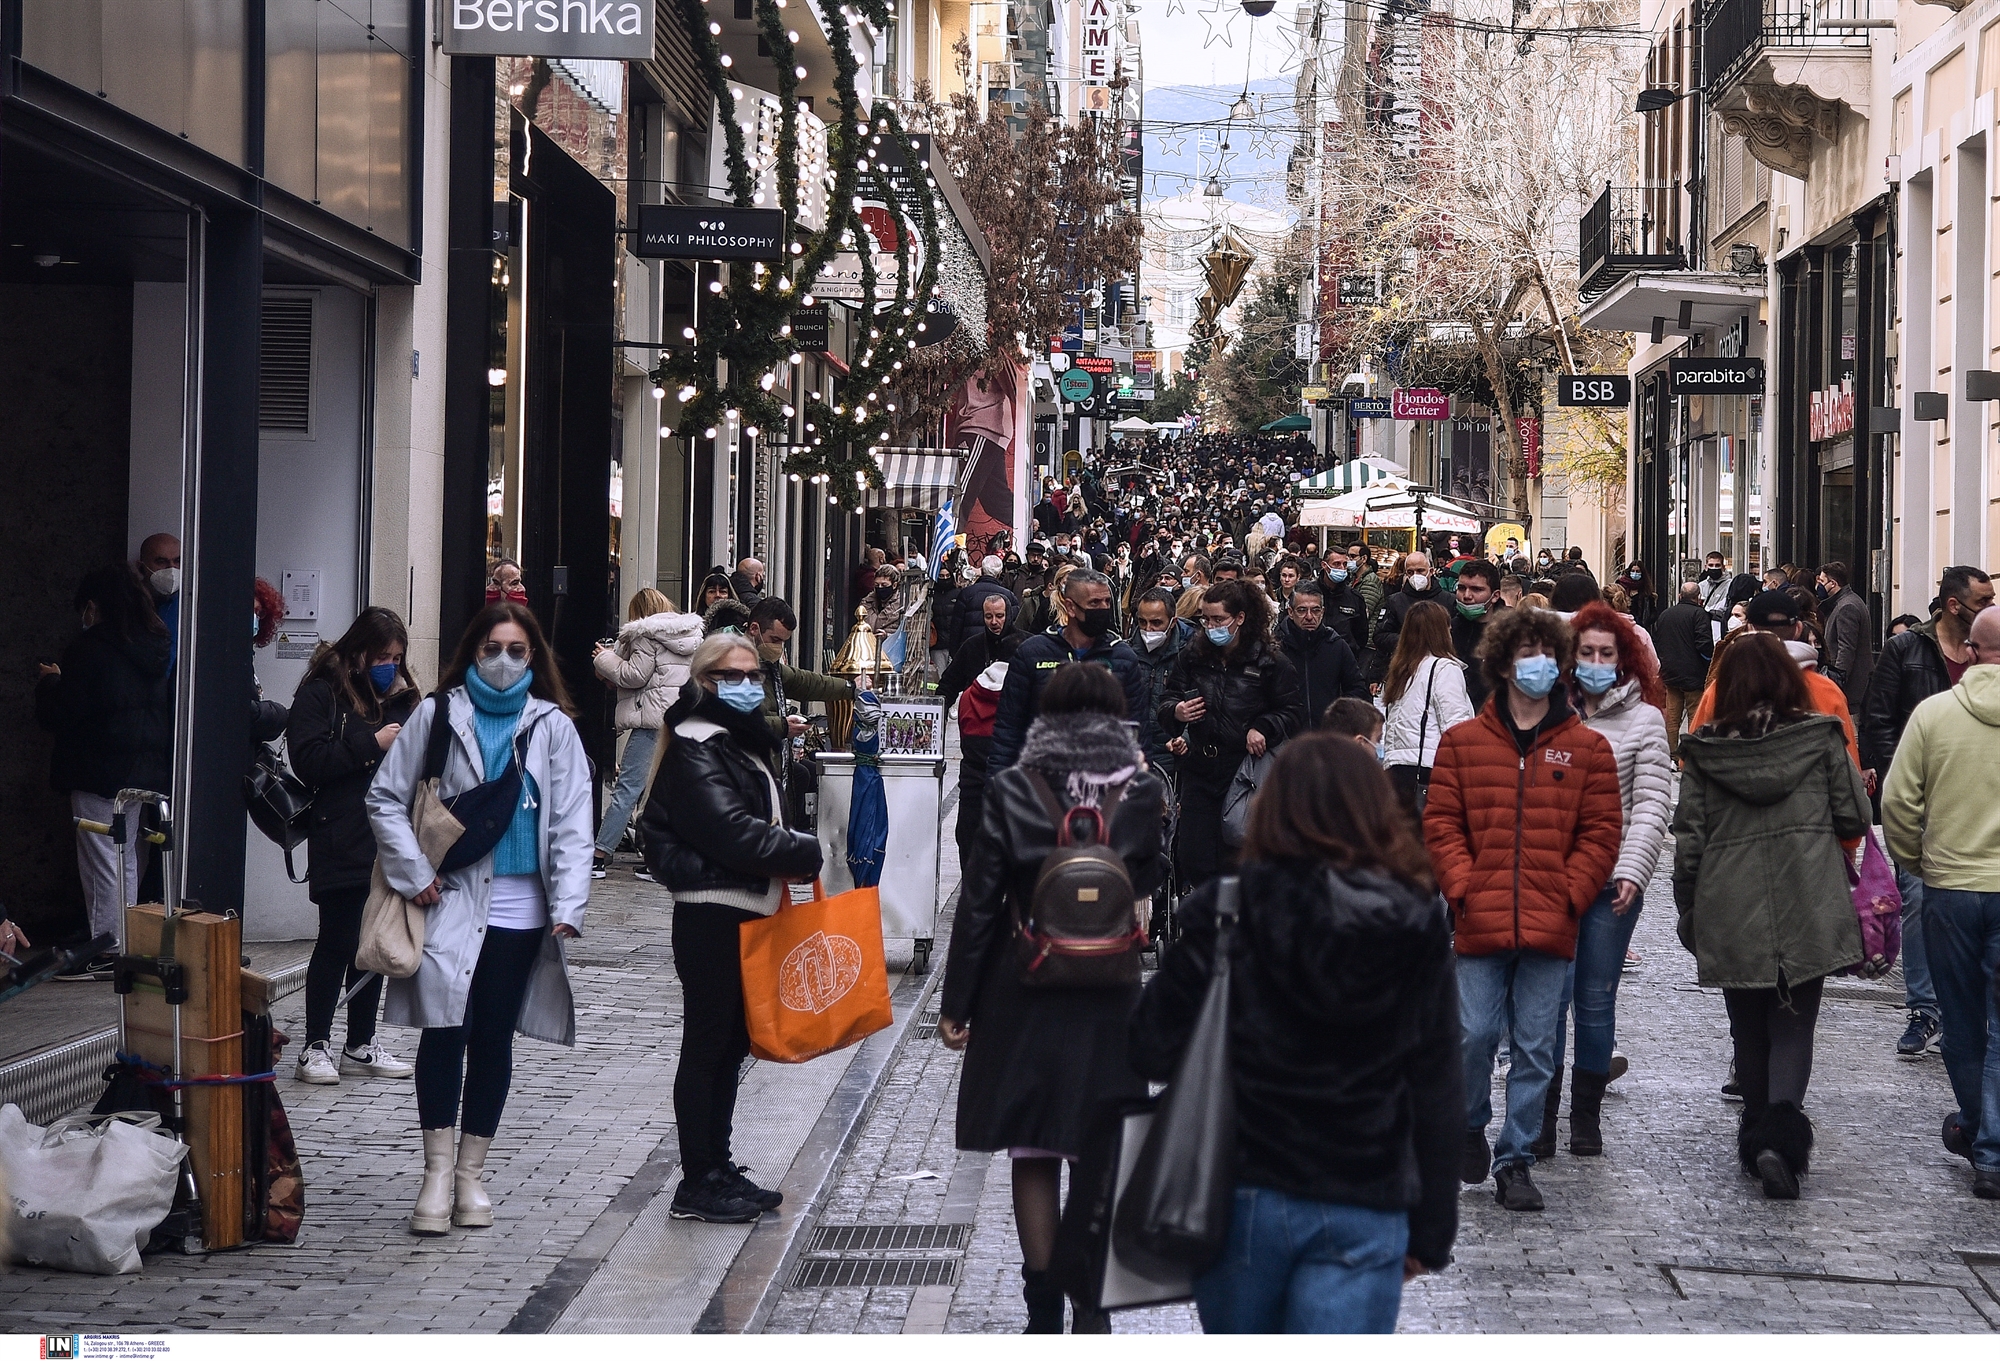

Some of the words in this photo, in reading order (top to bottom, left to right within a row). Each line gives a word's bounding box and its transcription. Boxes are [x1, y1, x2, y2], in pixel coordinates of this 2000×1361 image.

[453, 0, 642, 35] Bershka
[645, 233, 680, 245] MAKI
[688, 234, 775, 248] PHILOSOPHY
[794, 324, 824, 332] BRUNCH
[798, 339, 824, 347] UNCH
[1676, 369, 1745, 385] parabita
[1572, 381, 1615, 401] BSB
[1398, 392, 1445, 404] Hondos
[1398, 405, 1440, 416] Center
[881, 711, 939, 720] ΣΑΛΕΠΙ
[1545, 748, 1573, 763] EA7
